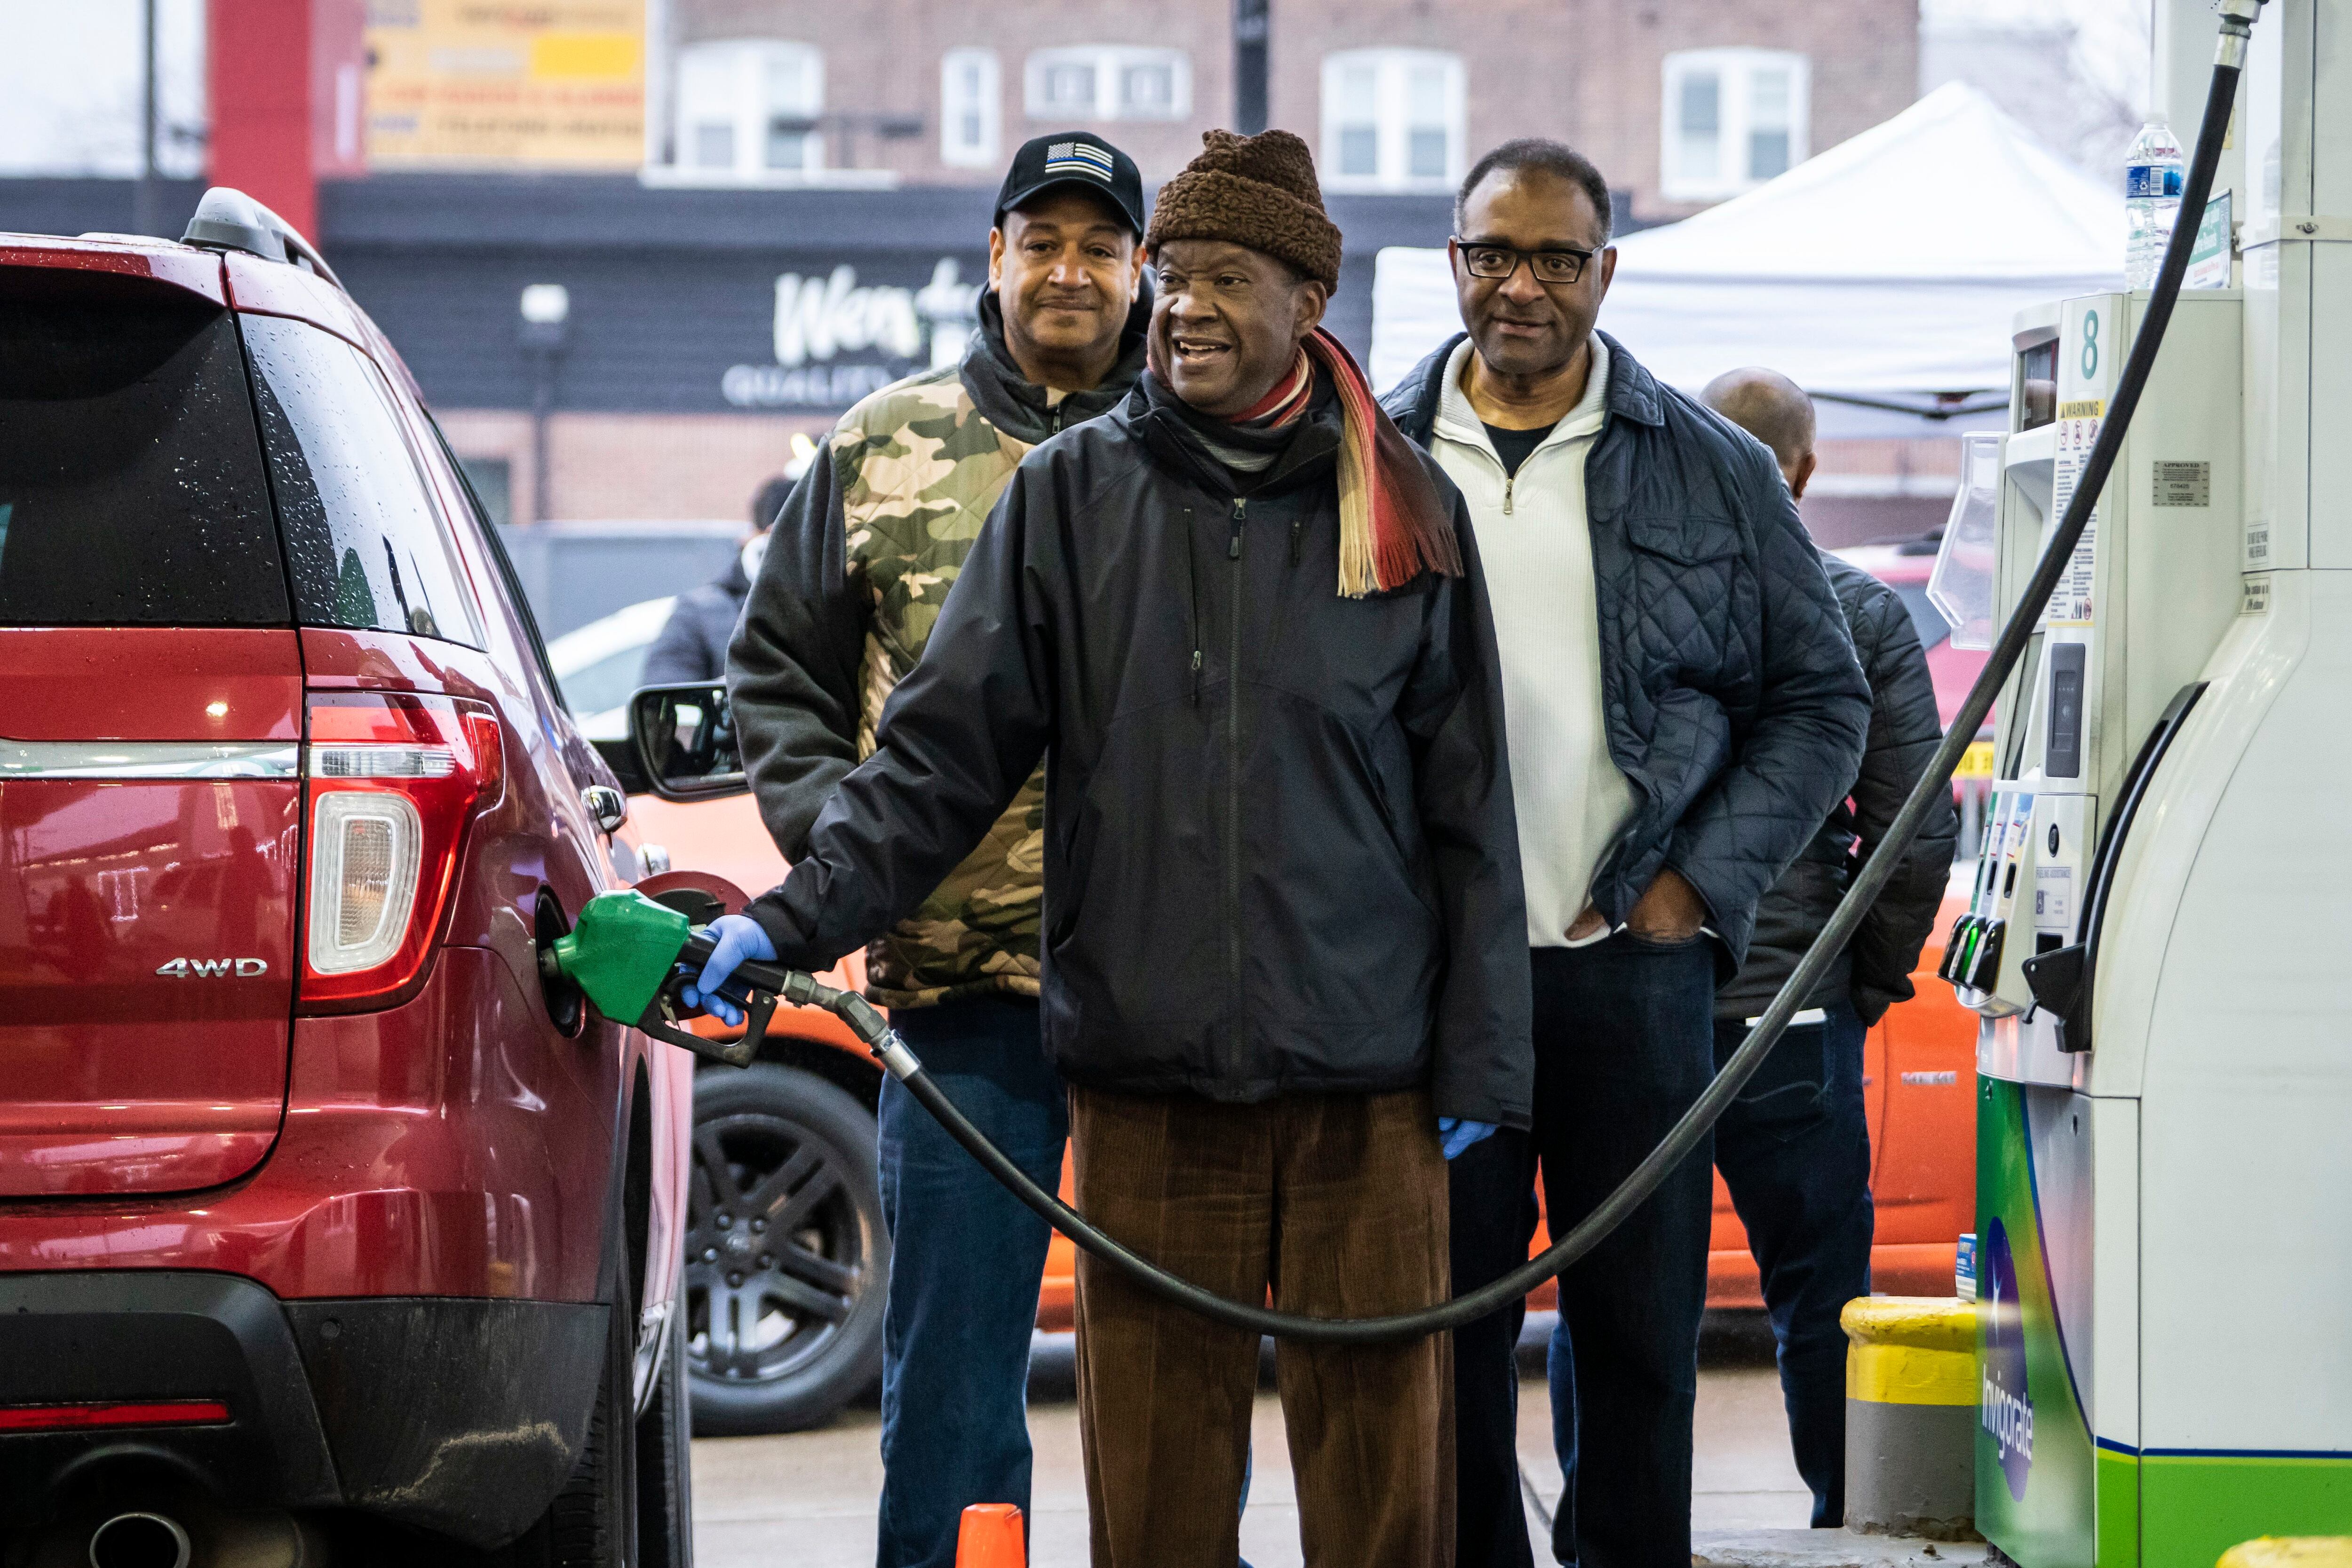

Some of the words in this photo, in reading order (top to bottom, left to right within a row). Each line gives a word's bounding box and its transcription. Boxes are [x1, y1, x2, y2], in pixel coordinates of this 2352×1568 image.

[2081, 309, 2098, 380] 8
[2066, 401, 2099, 417] WARNING
[155, 957, 268, 978] 4WD
[1982, 1362, 2034, 1461] Invigorate
